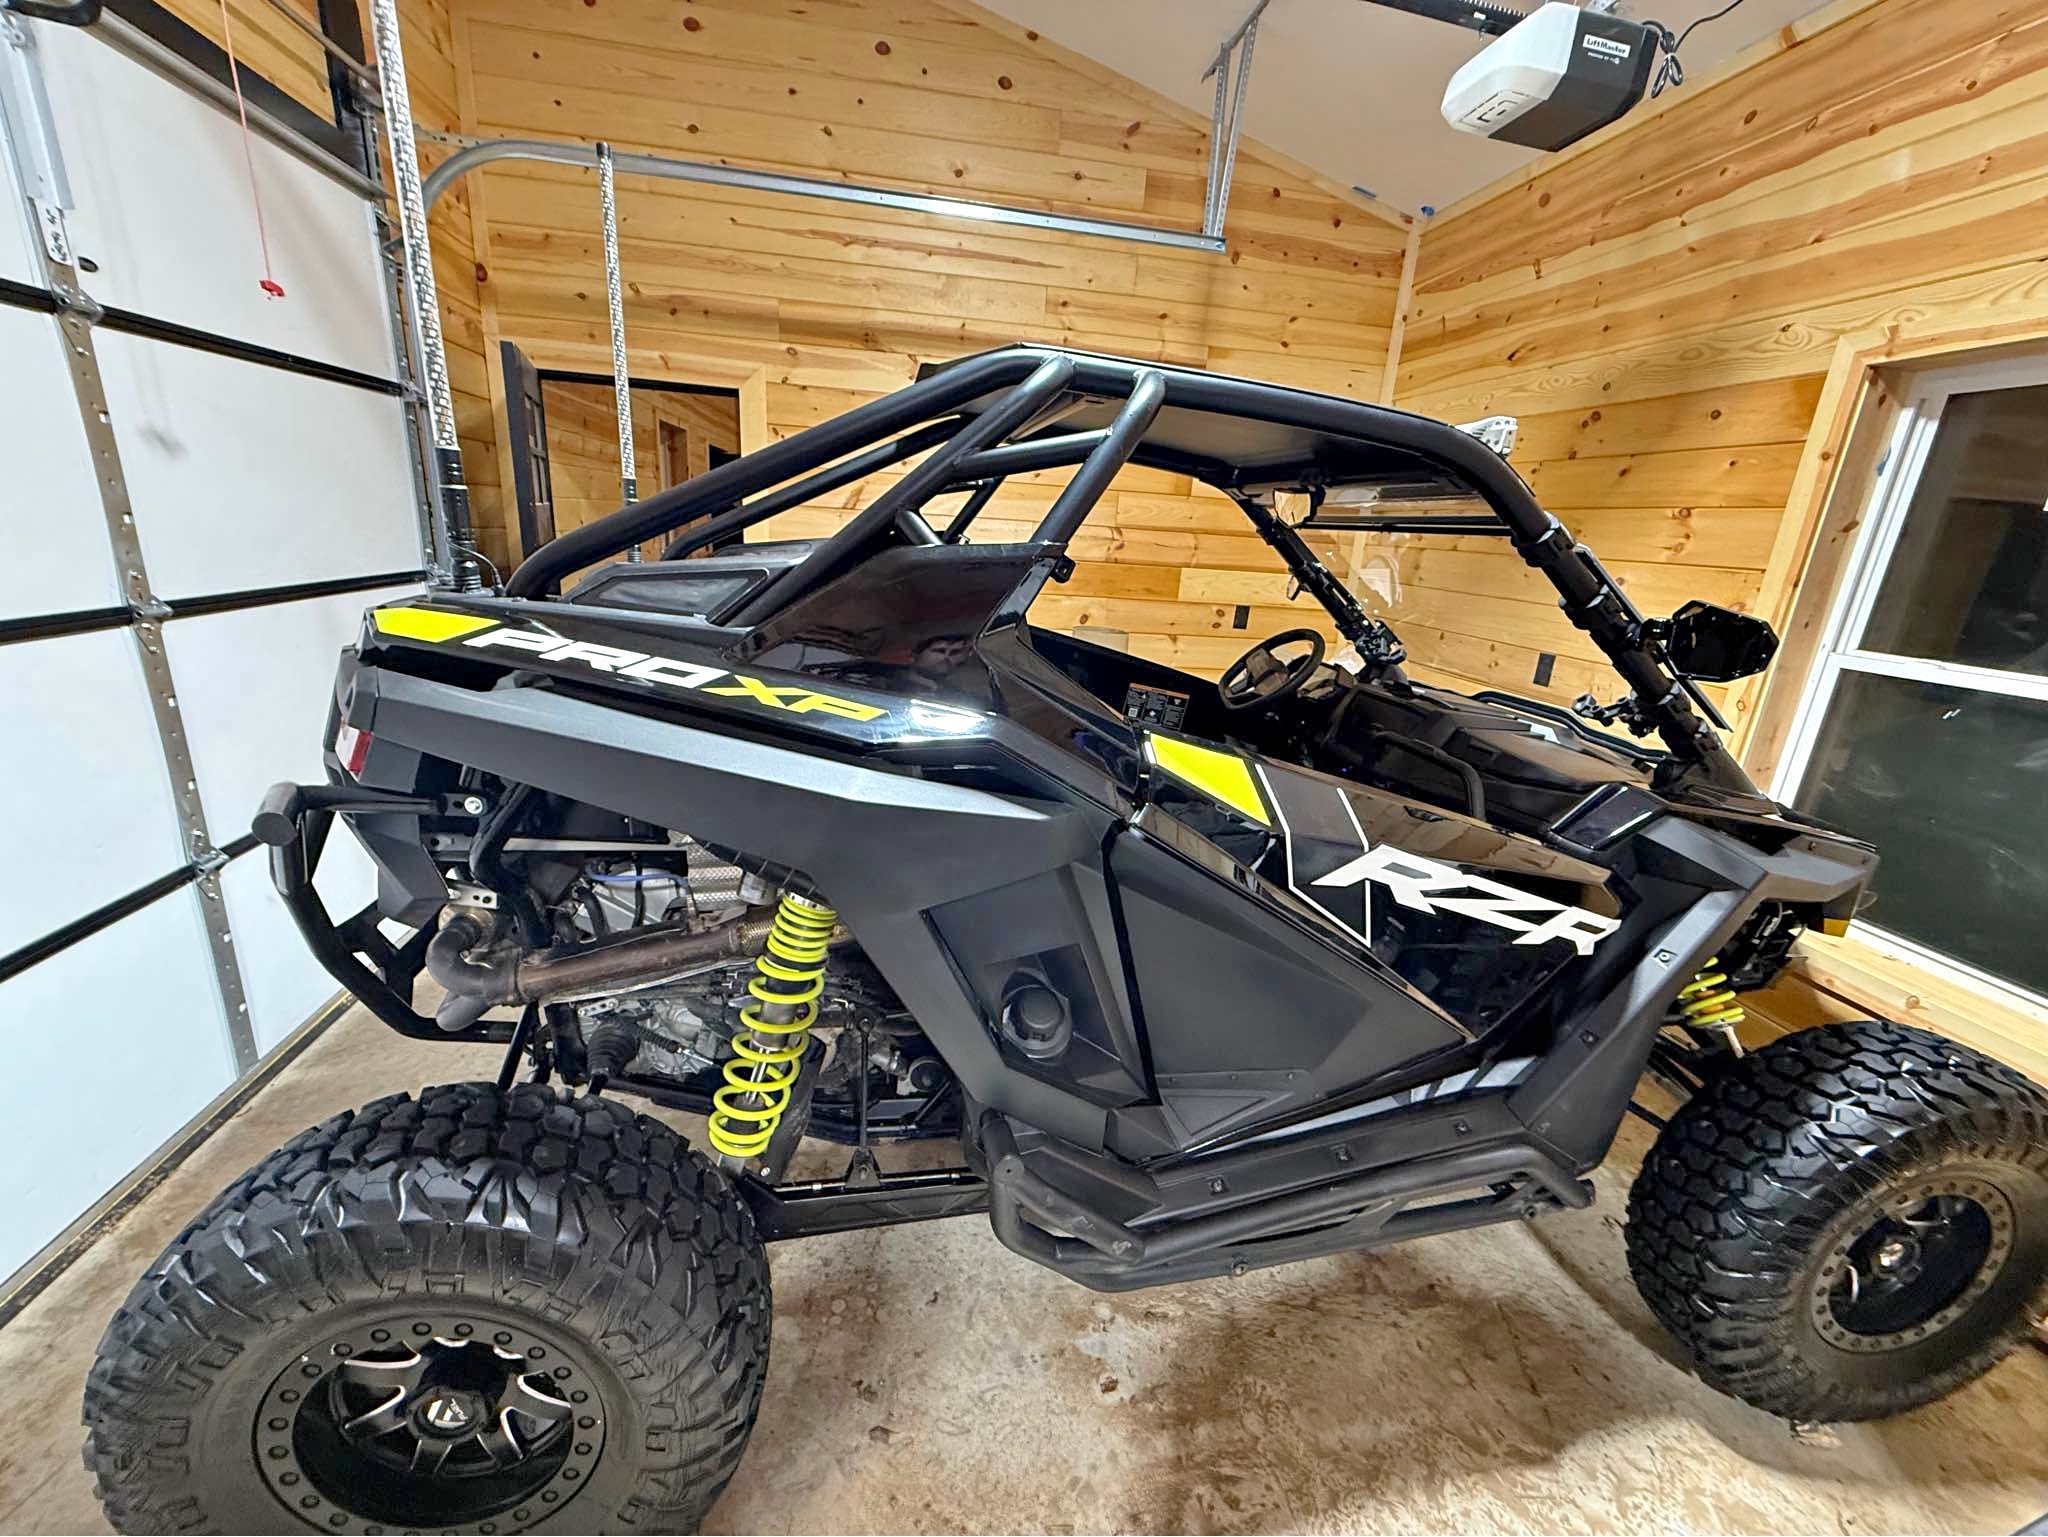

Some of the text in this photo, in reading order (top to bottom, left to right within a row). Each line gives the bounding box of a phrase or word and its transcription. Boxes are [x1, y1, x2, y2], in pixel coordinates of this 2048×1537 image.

[1586, 37, 1627, 54] LiftMaster
[461, 628, 889, 722] PRO XP
[1310, 844, 1622, 956] RZR
